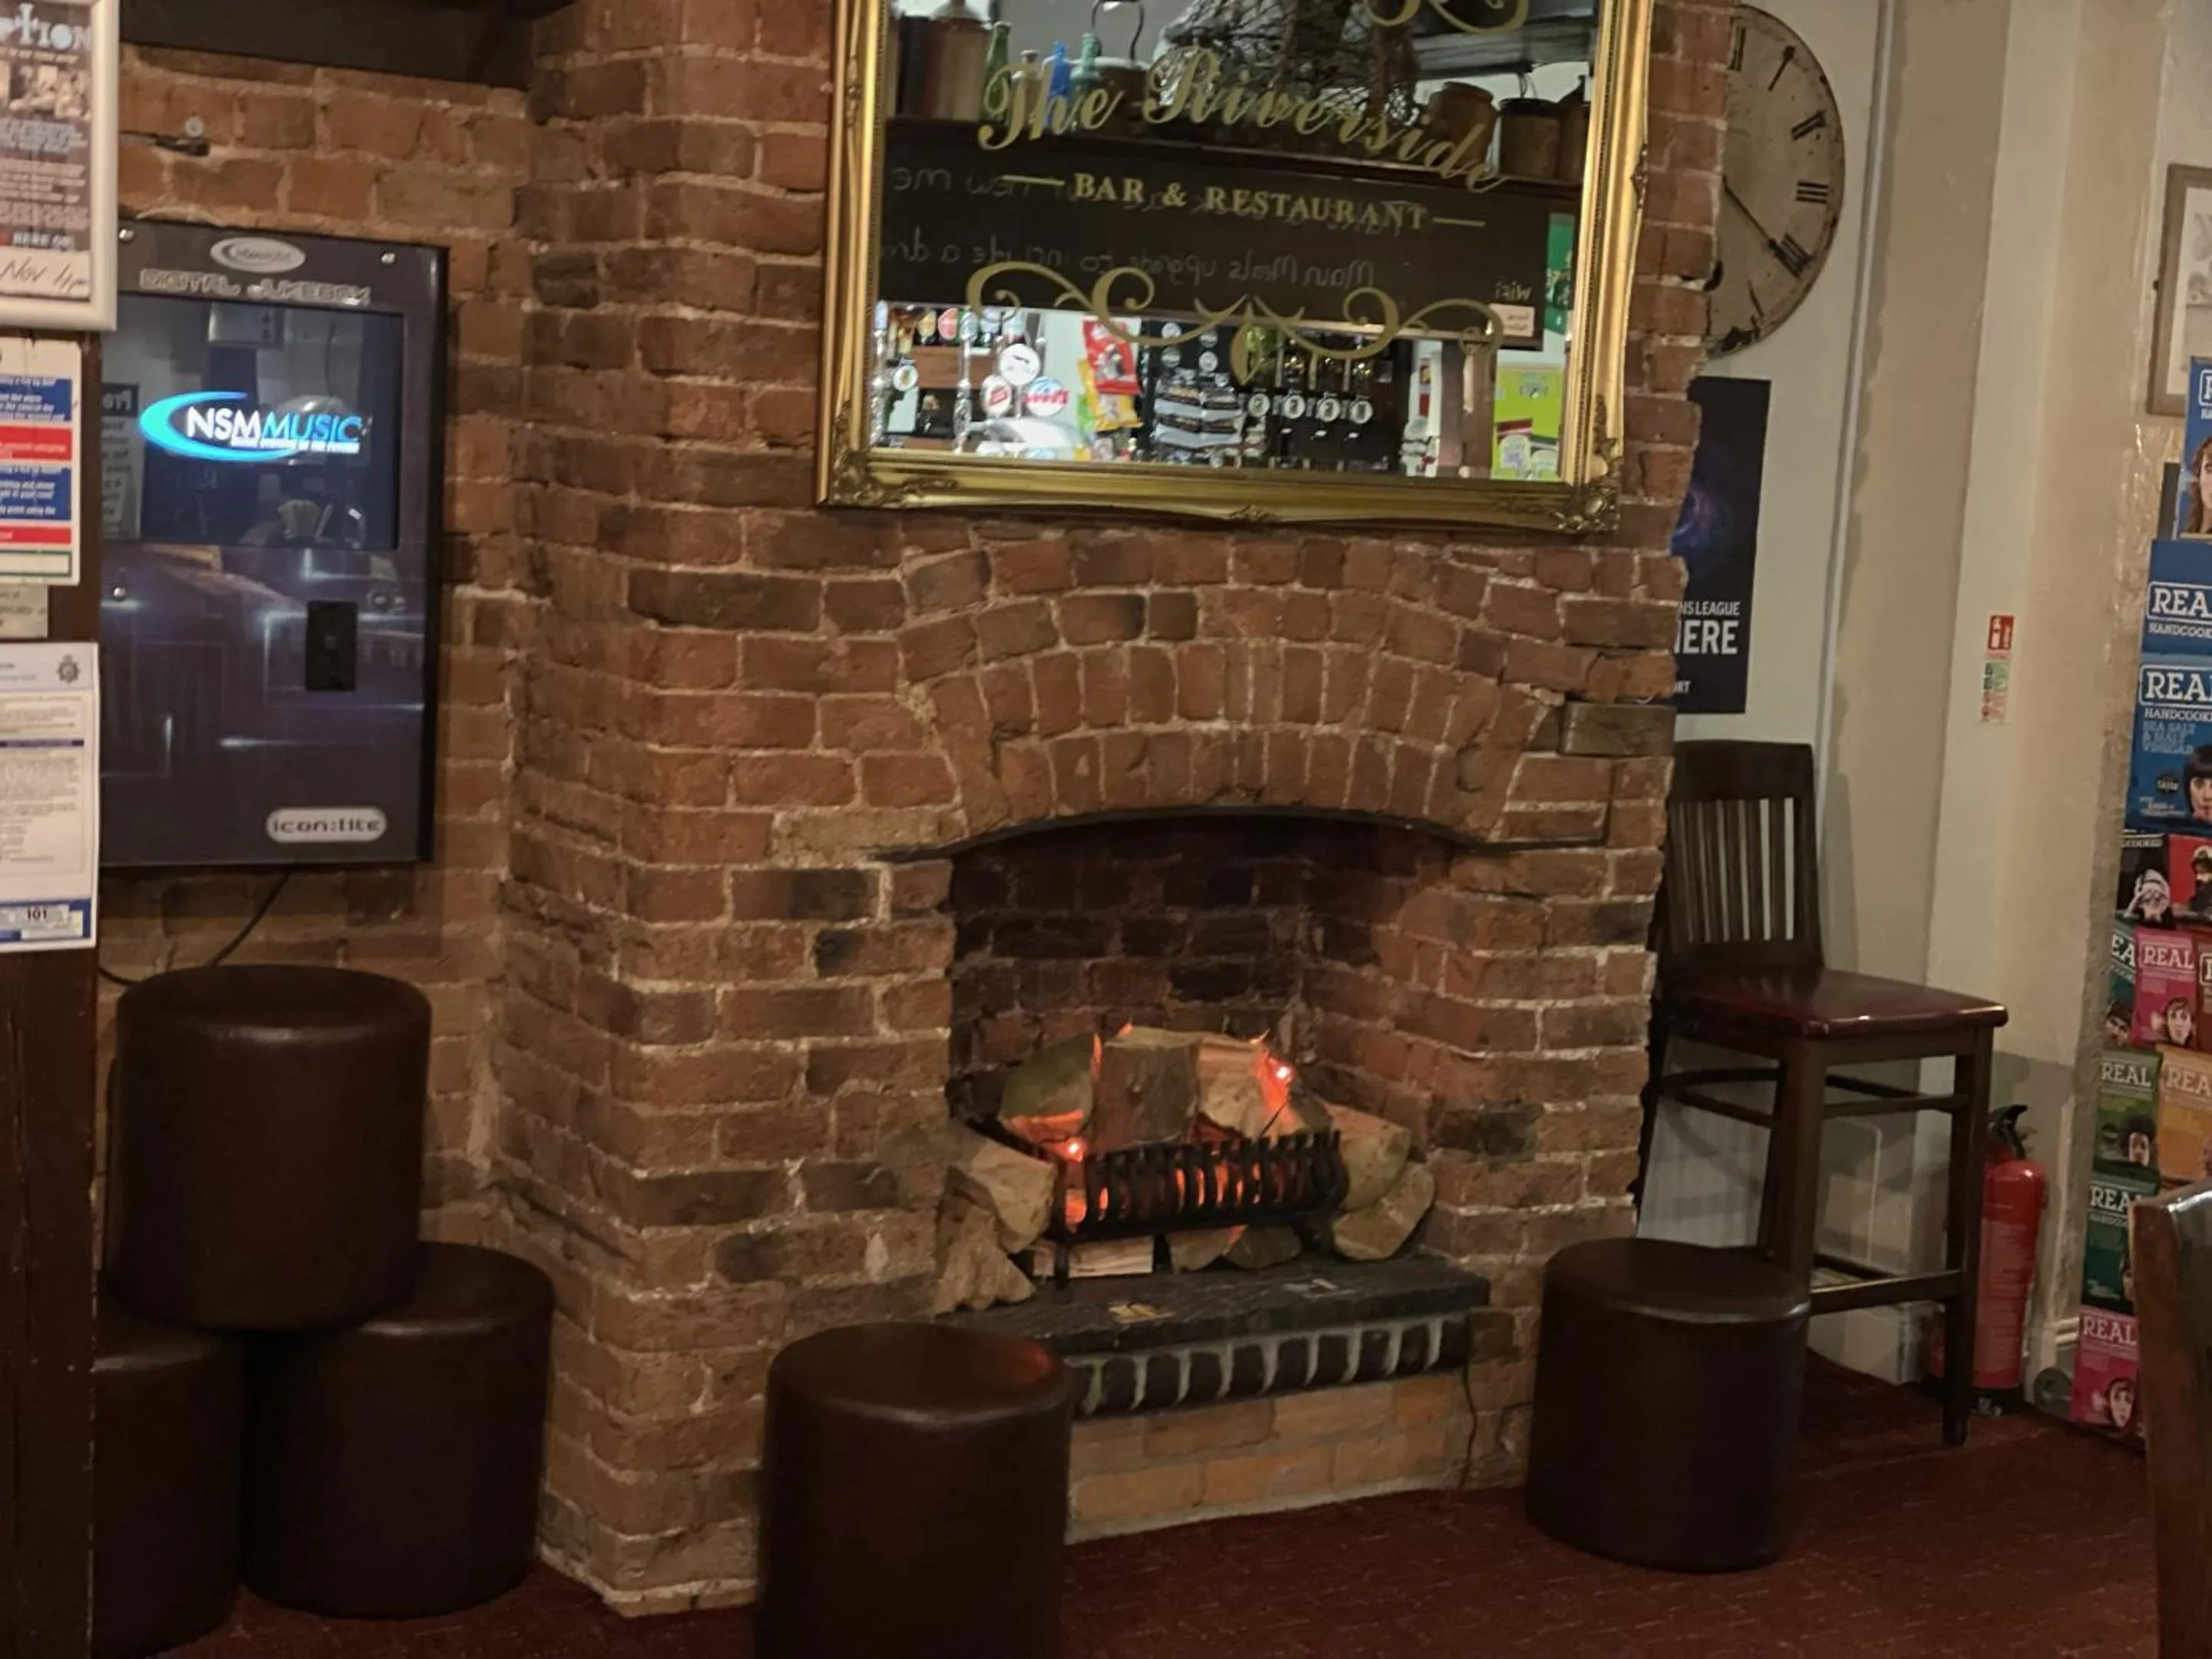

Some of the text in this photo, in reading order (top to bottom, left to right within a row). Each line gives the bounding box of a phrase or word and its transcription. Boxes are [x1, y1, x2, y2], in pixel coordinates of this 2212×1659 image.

[978, 45, 1509, 193] The Riverside
[1074, 173, 1145, 203] BAR
[1161, 182, 1187, 207] &
[1205, 186, 1427, 230] RESTAURANT
[1695, 601, 1741, 616] LEAGUE
[2151, 587, 2212, 618] REA
[2144, 671, 2212, 702] REA
[2144, 945, 2194, 970] REAL
[2101, 1062, 2151, 1087] REAL
[2166, 1066, 2212, 1097] REA
[2090, 1186, 2142, 1212] REA
[2082, 1316, 2137, 1345] REAL
